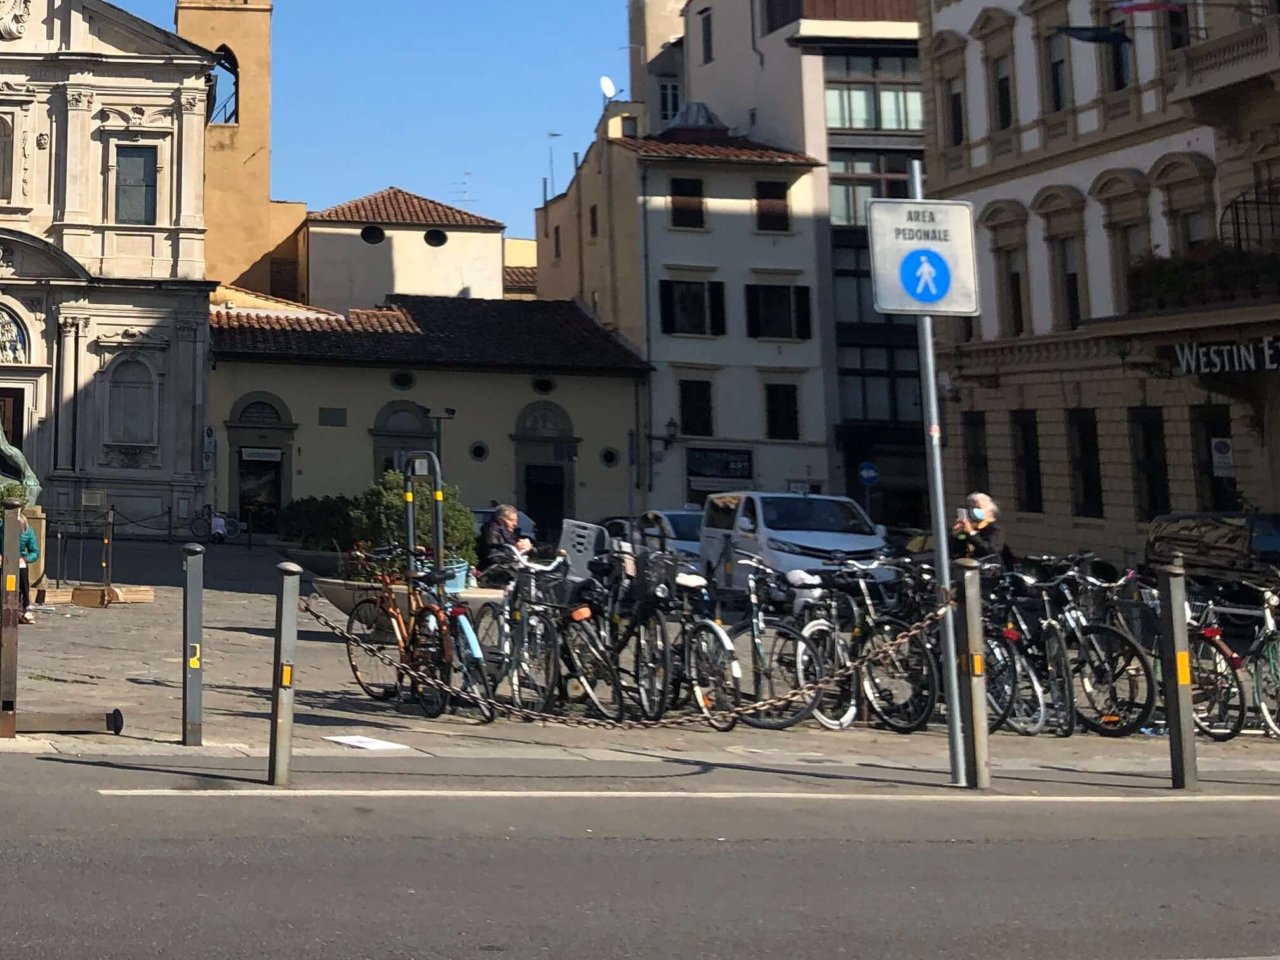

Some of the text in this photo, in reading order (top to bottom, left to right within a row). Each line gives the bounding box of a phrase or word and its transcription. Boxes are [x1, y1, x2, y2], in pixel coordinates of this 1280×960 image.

[907, 210, 936, 223] AREA
[894, 228, 951, 242] PEDONALE
[1175, 337, 1280, 374] WESTIN E
